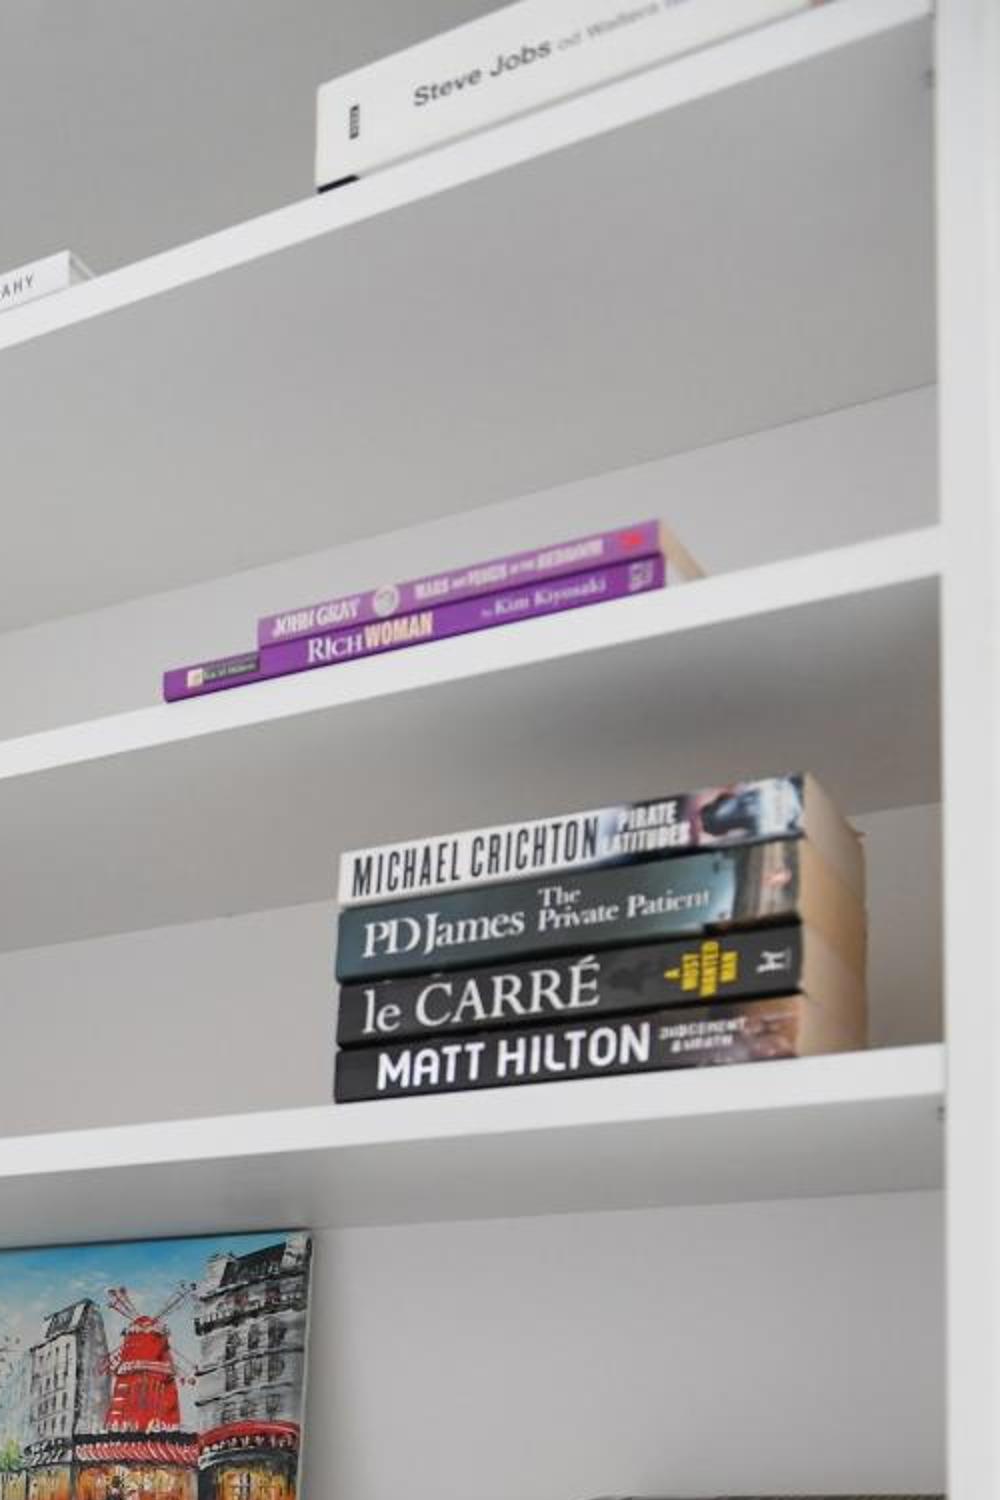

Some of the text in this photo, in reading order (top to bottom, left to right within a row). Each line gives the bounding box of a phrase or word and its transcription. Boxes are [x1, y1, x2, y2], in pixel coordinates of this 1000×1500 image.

[413, 66, 482, 107] Steve
[490, 39, 553, 77] Jobs
[316, 598, 361, 626] GRAY
[363, 610, 434, 649] WOMAN
[351, 815, 599, 898] MICHAEL CRICHTON
[537, 885, 581, 907] The
[537, 889, 711, 932] Private Patient
[361, 954, 600, 1034] le CARRÉ
[377, 1022, 650, 1091] MATT HILTON
